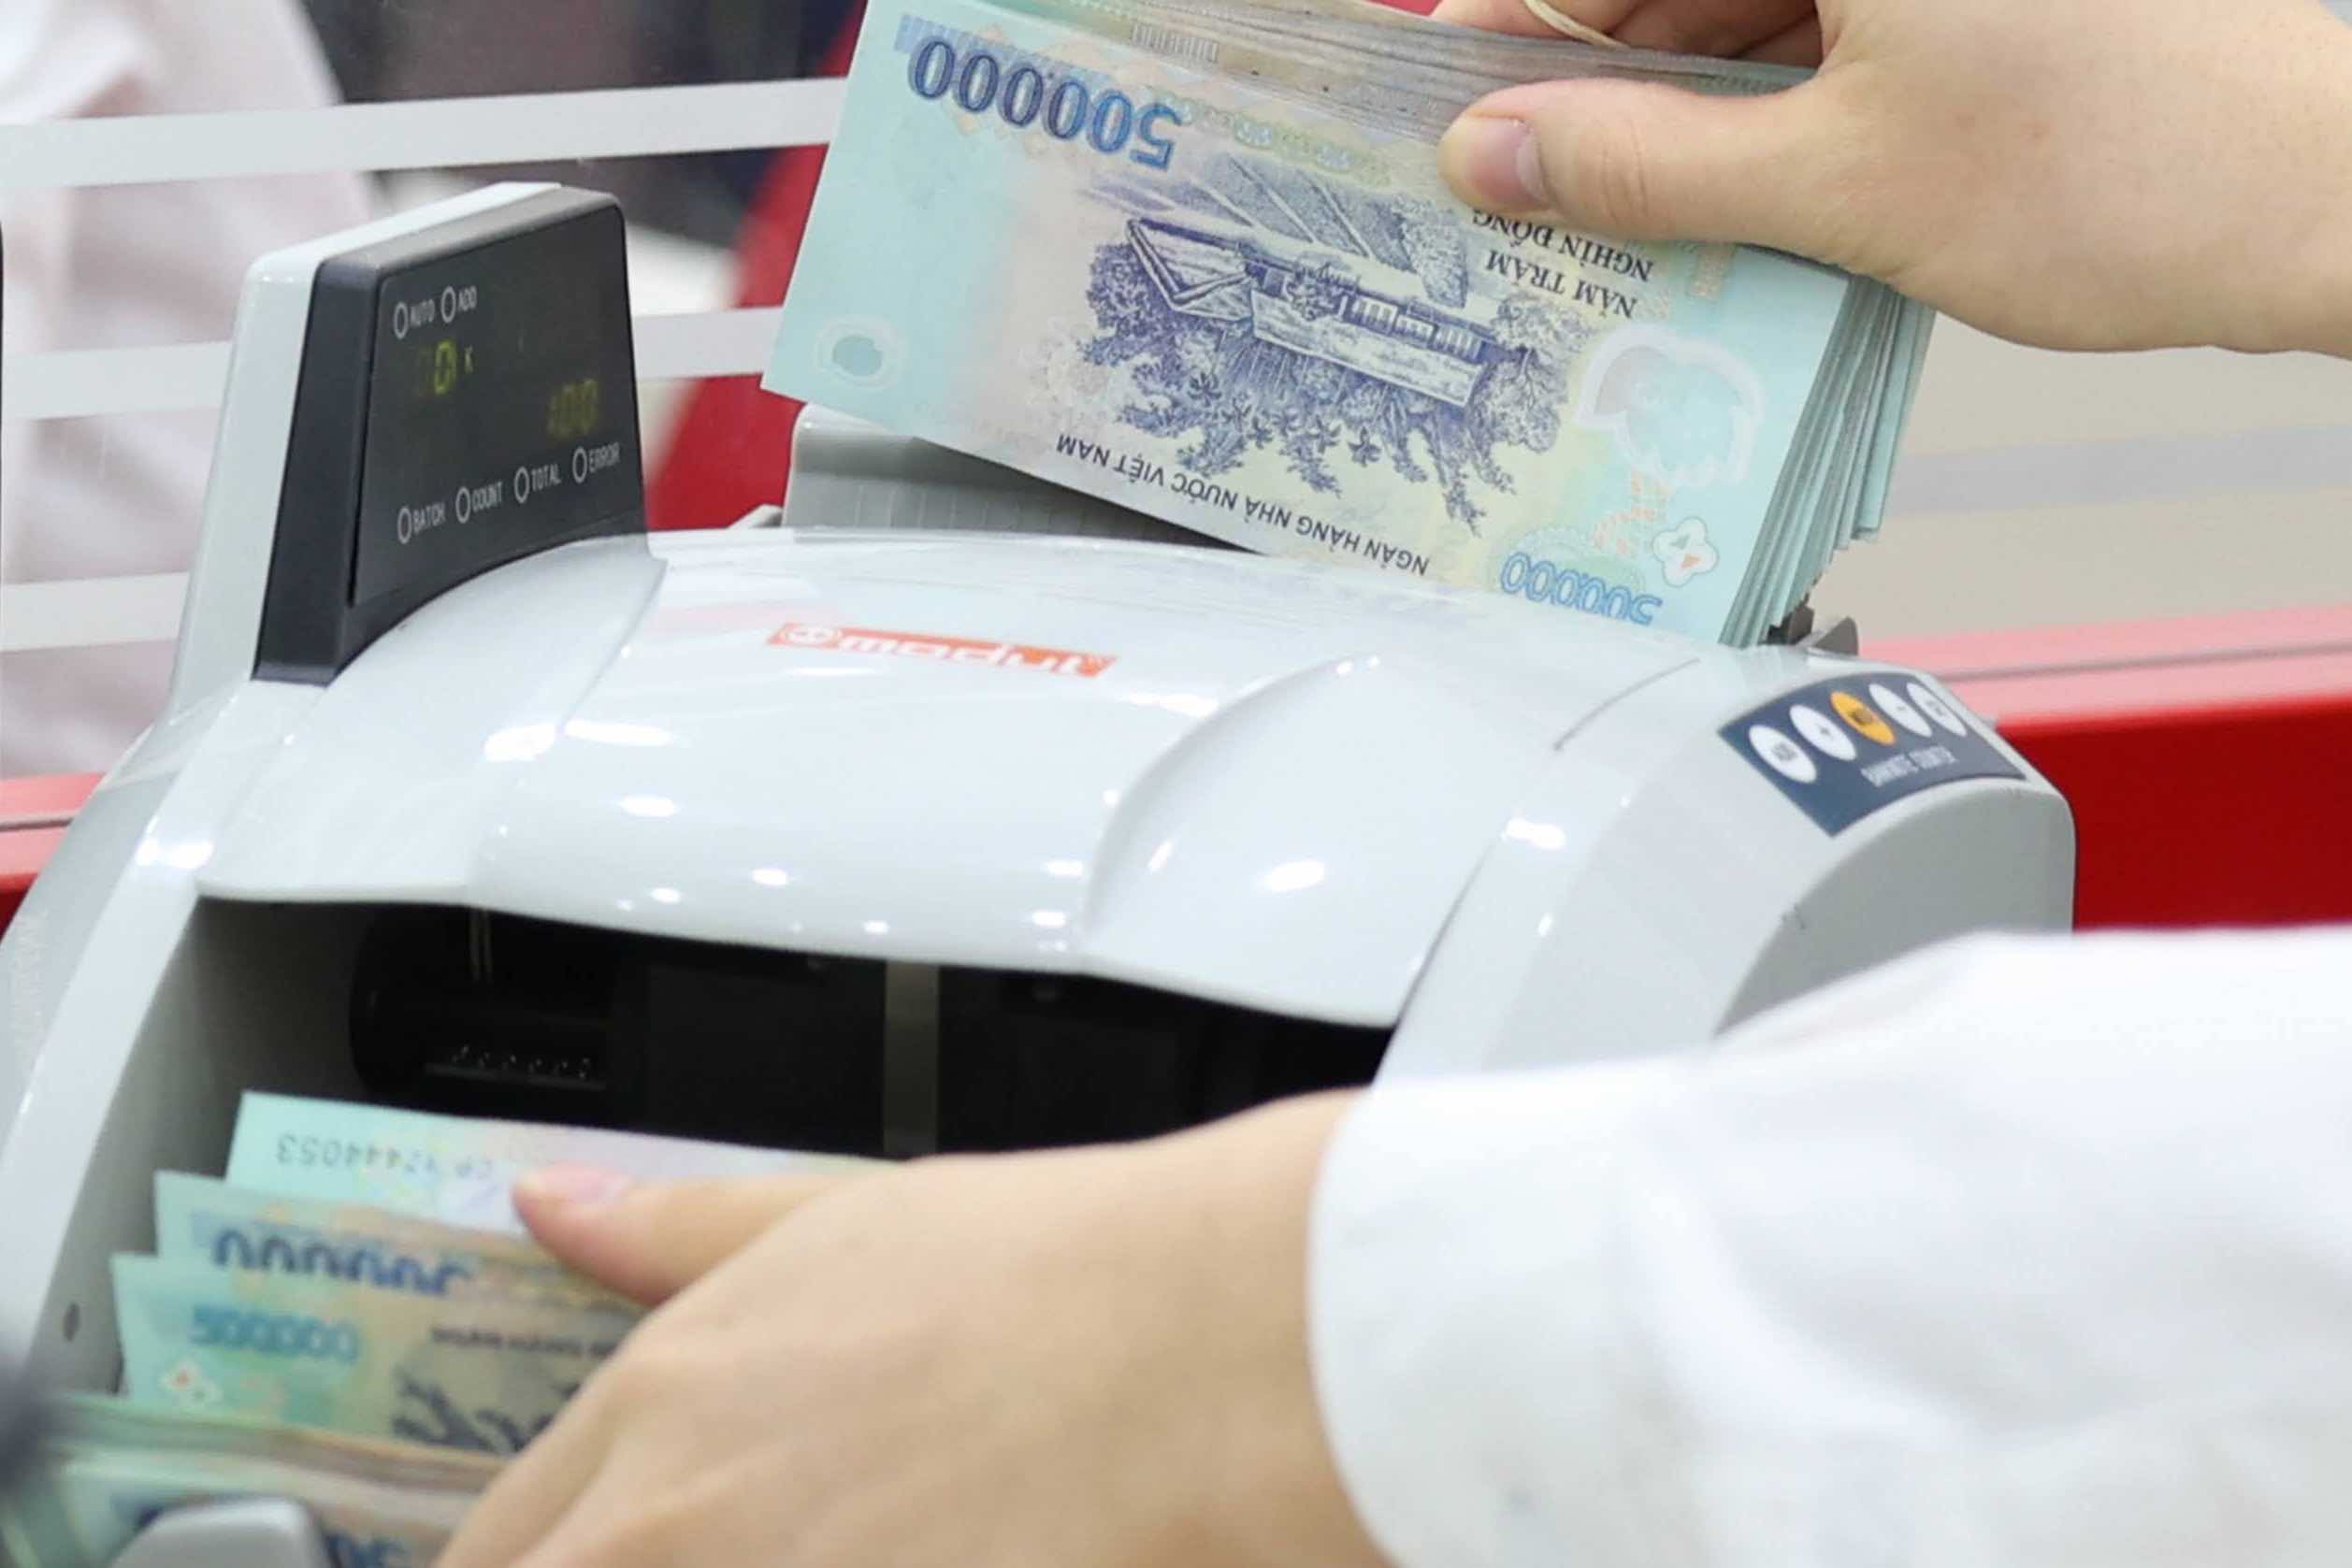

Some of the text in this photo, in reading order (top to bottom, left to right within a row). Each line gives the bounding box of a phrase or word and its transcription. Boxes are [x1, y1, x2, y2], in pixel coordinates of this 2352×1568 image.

[1484, 249, 1638, 319] NĂM TRĂM
[1558, 230, 1654, 282] NGHÌN
[1056, 432, 1431, 577] NGÂN HÀNG NHÀ NƯỚC VIỆT NAM
